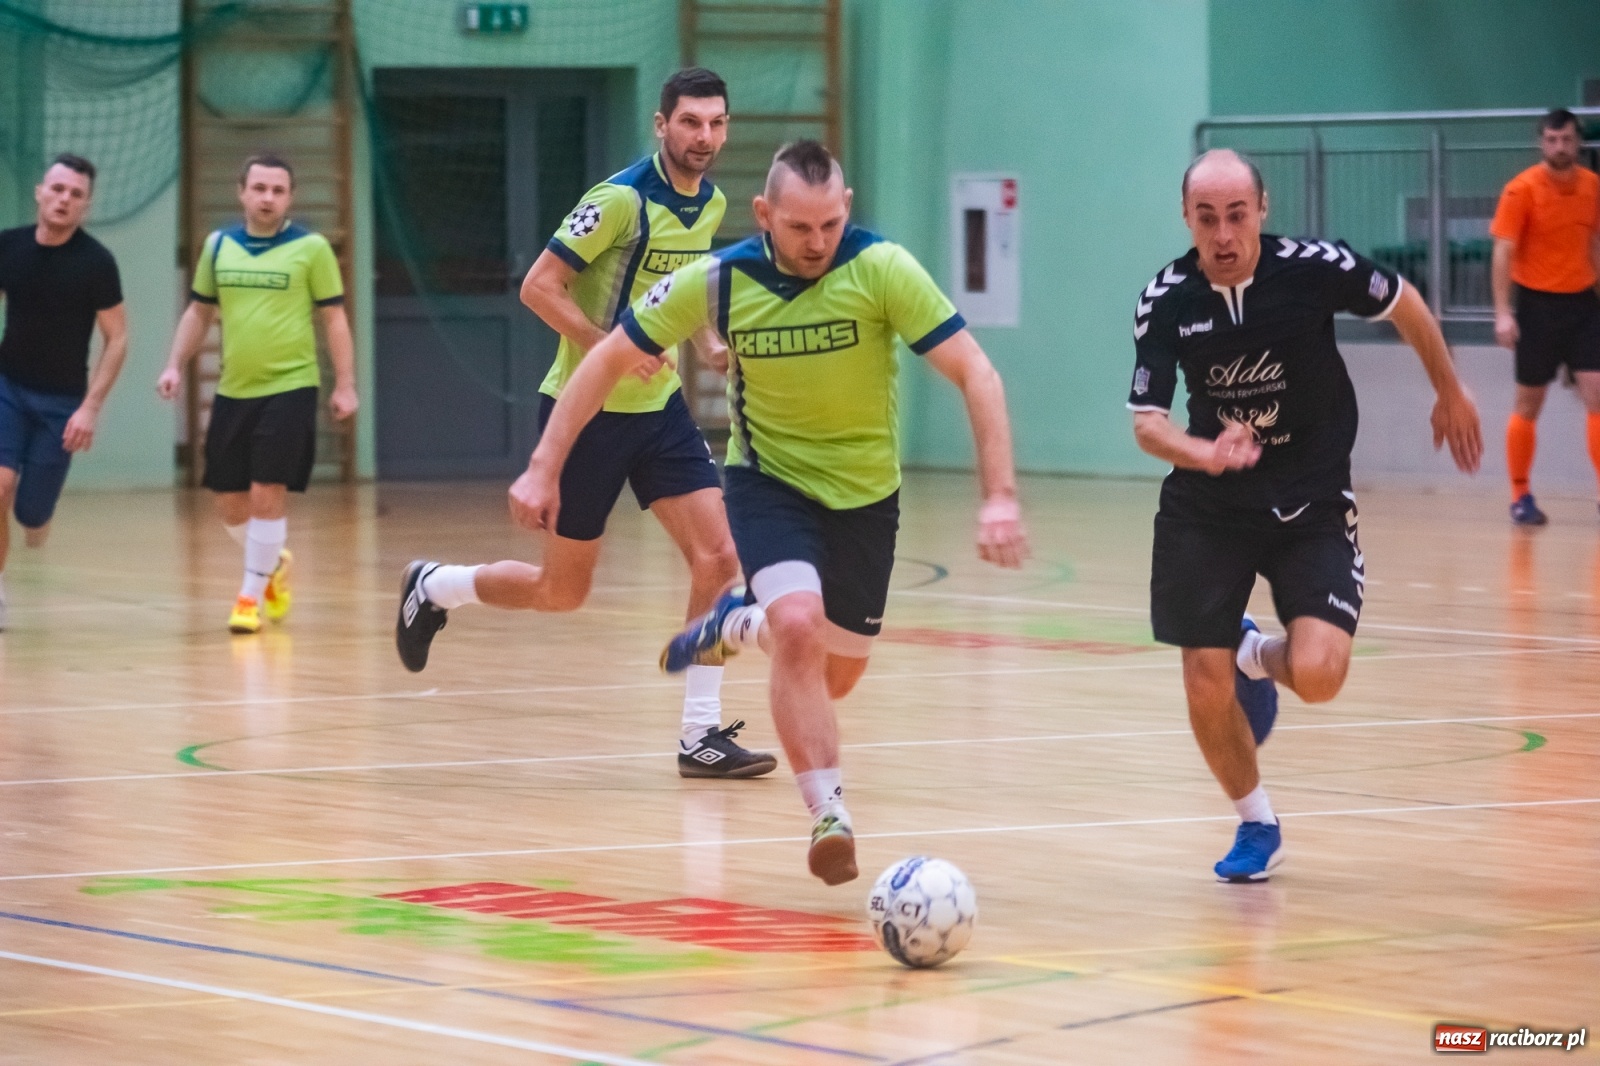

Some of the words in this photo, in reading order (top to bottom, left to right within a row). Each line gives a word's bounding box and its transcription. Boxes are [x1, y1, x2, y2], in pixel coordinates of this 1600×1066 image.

[645, 251, 706, 273] KRU
[735, 321, 856, 356] KRUKS
[1205, 349, 1284, 388] Ada
